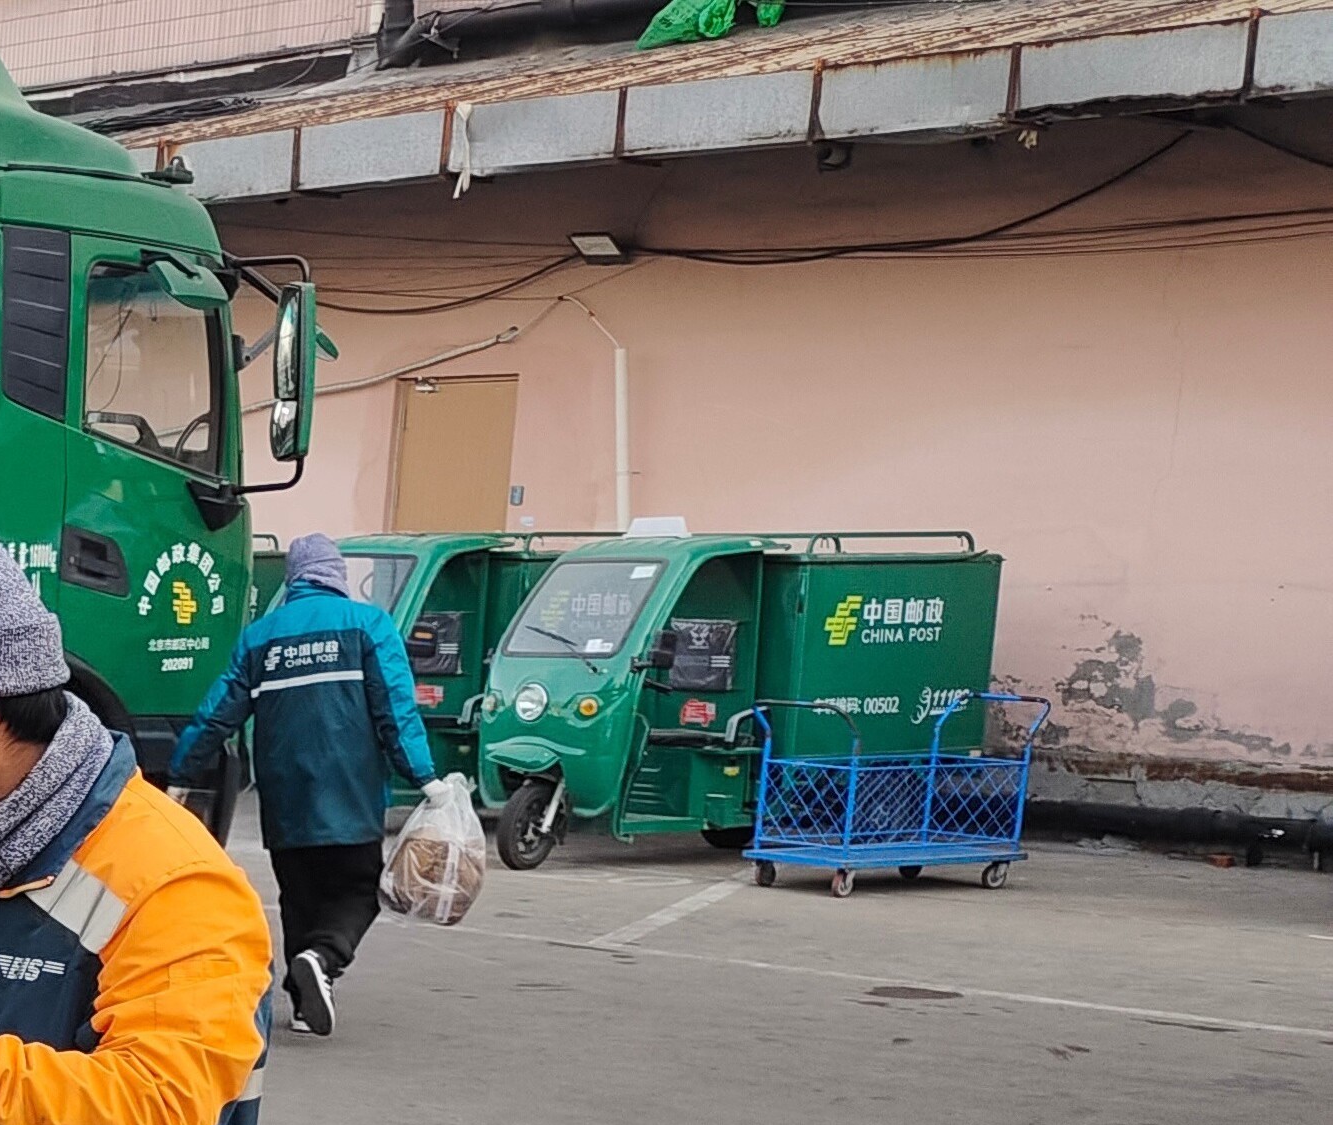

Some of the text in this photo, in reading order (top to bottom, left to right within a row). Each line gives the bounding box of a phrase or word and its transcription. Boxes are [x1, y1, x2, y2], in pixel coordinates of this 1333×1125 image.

[137, 541, 225, 616] 中国邮政集团公司
[862, 596, 944, 627] 中国邮政
[861, 626, 942, 645] CHINA POST
[284, 641, 339, 660] 中国邮政
[284, 657, 313, 669] CHINA
